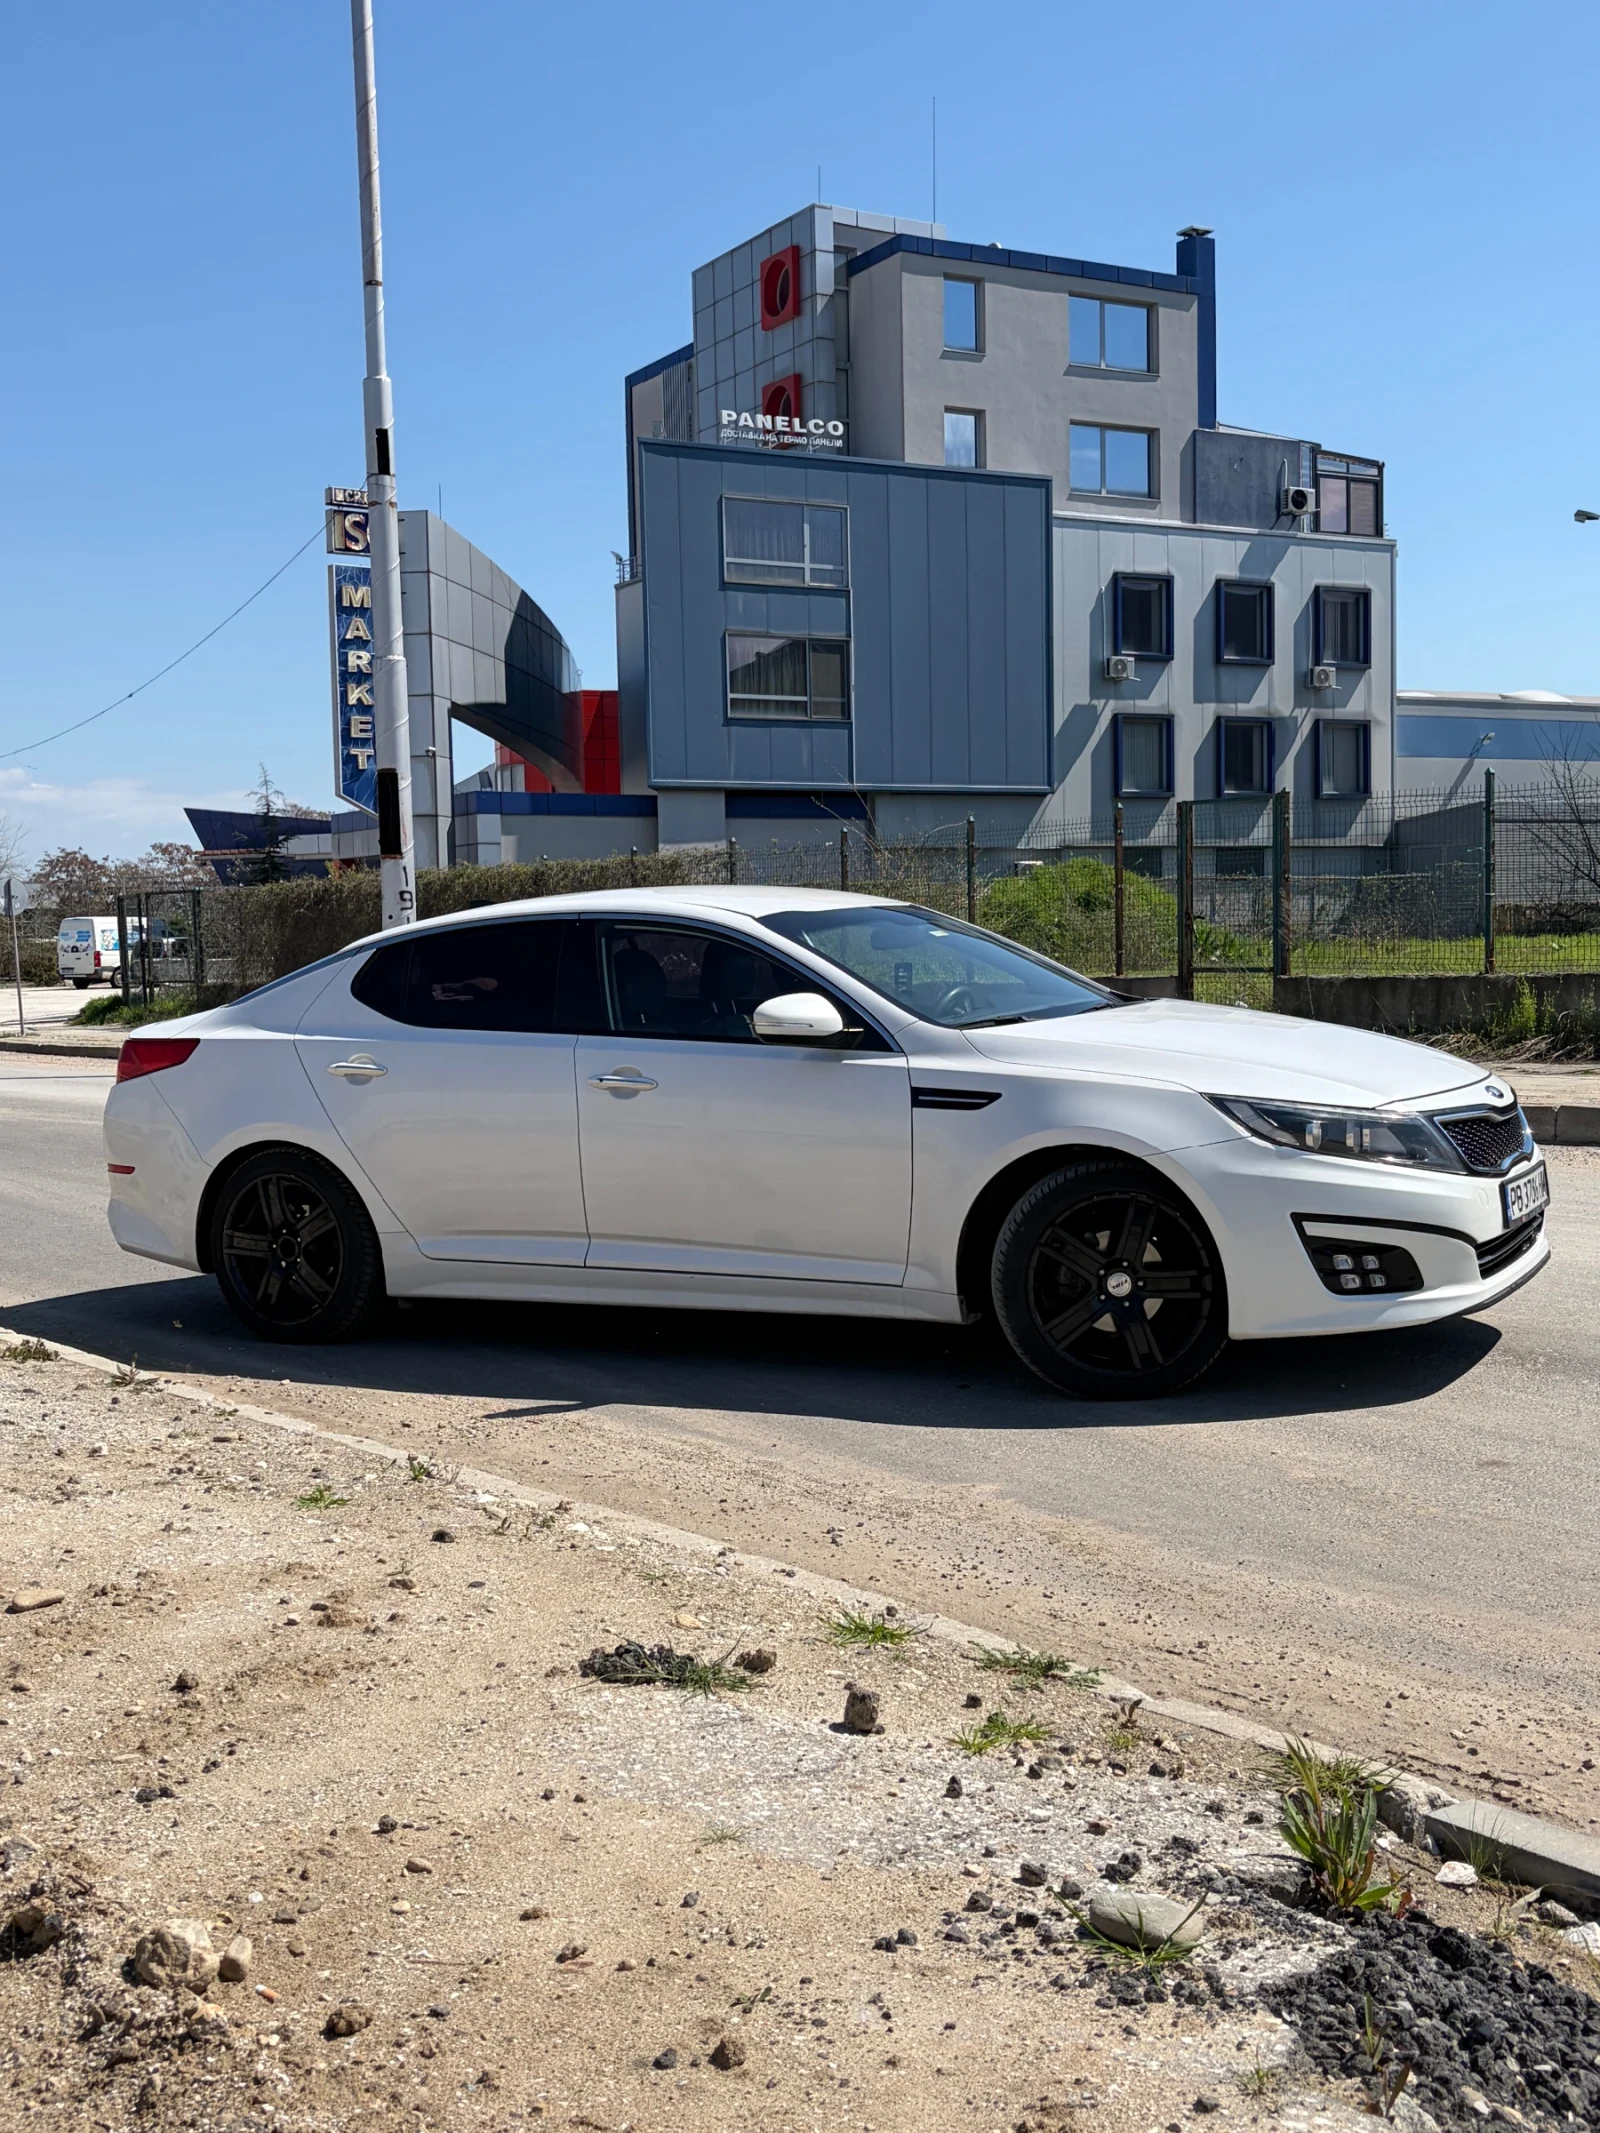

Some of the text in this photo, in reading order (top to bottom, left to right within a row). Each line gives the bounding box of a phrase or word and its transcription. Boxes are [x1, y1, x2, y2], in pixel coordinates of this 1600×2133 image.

[720, 409, 844, 436] PANELCO
[720, 429, 843, 448] ДОСТАВКА НА ТЕРМО ПАНЕЛИ
[334, 511, 371, 551] IS
[341, 584, 375, 770] MARKET
[898, 968, 907, 992] VIP
